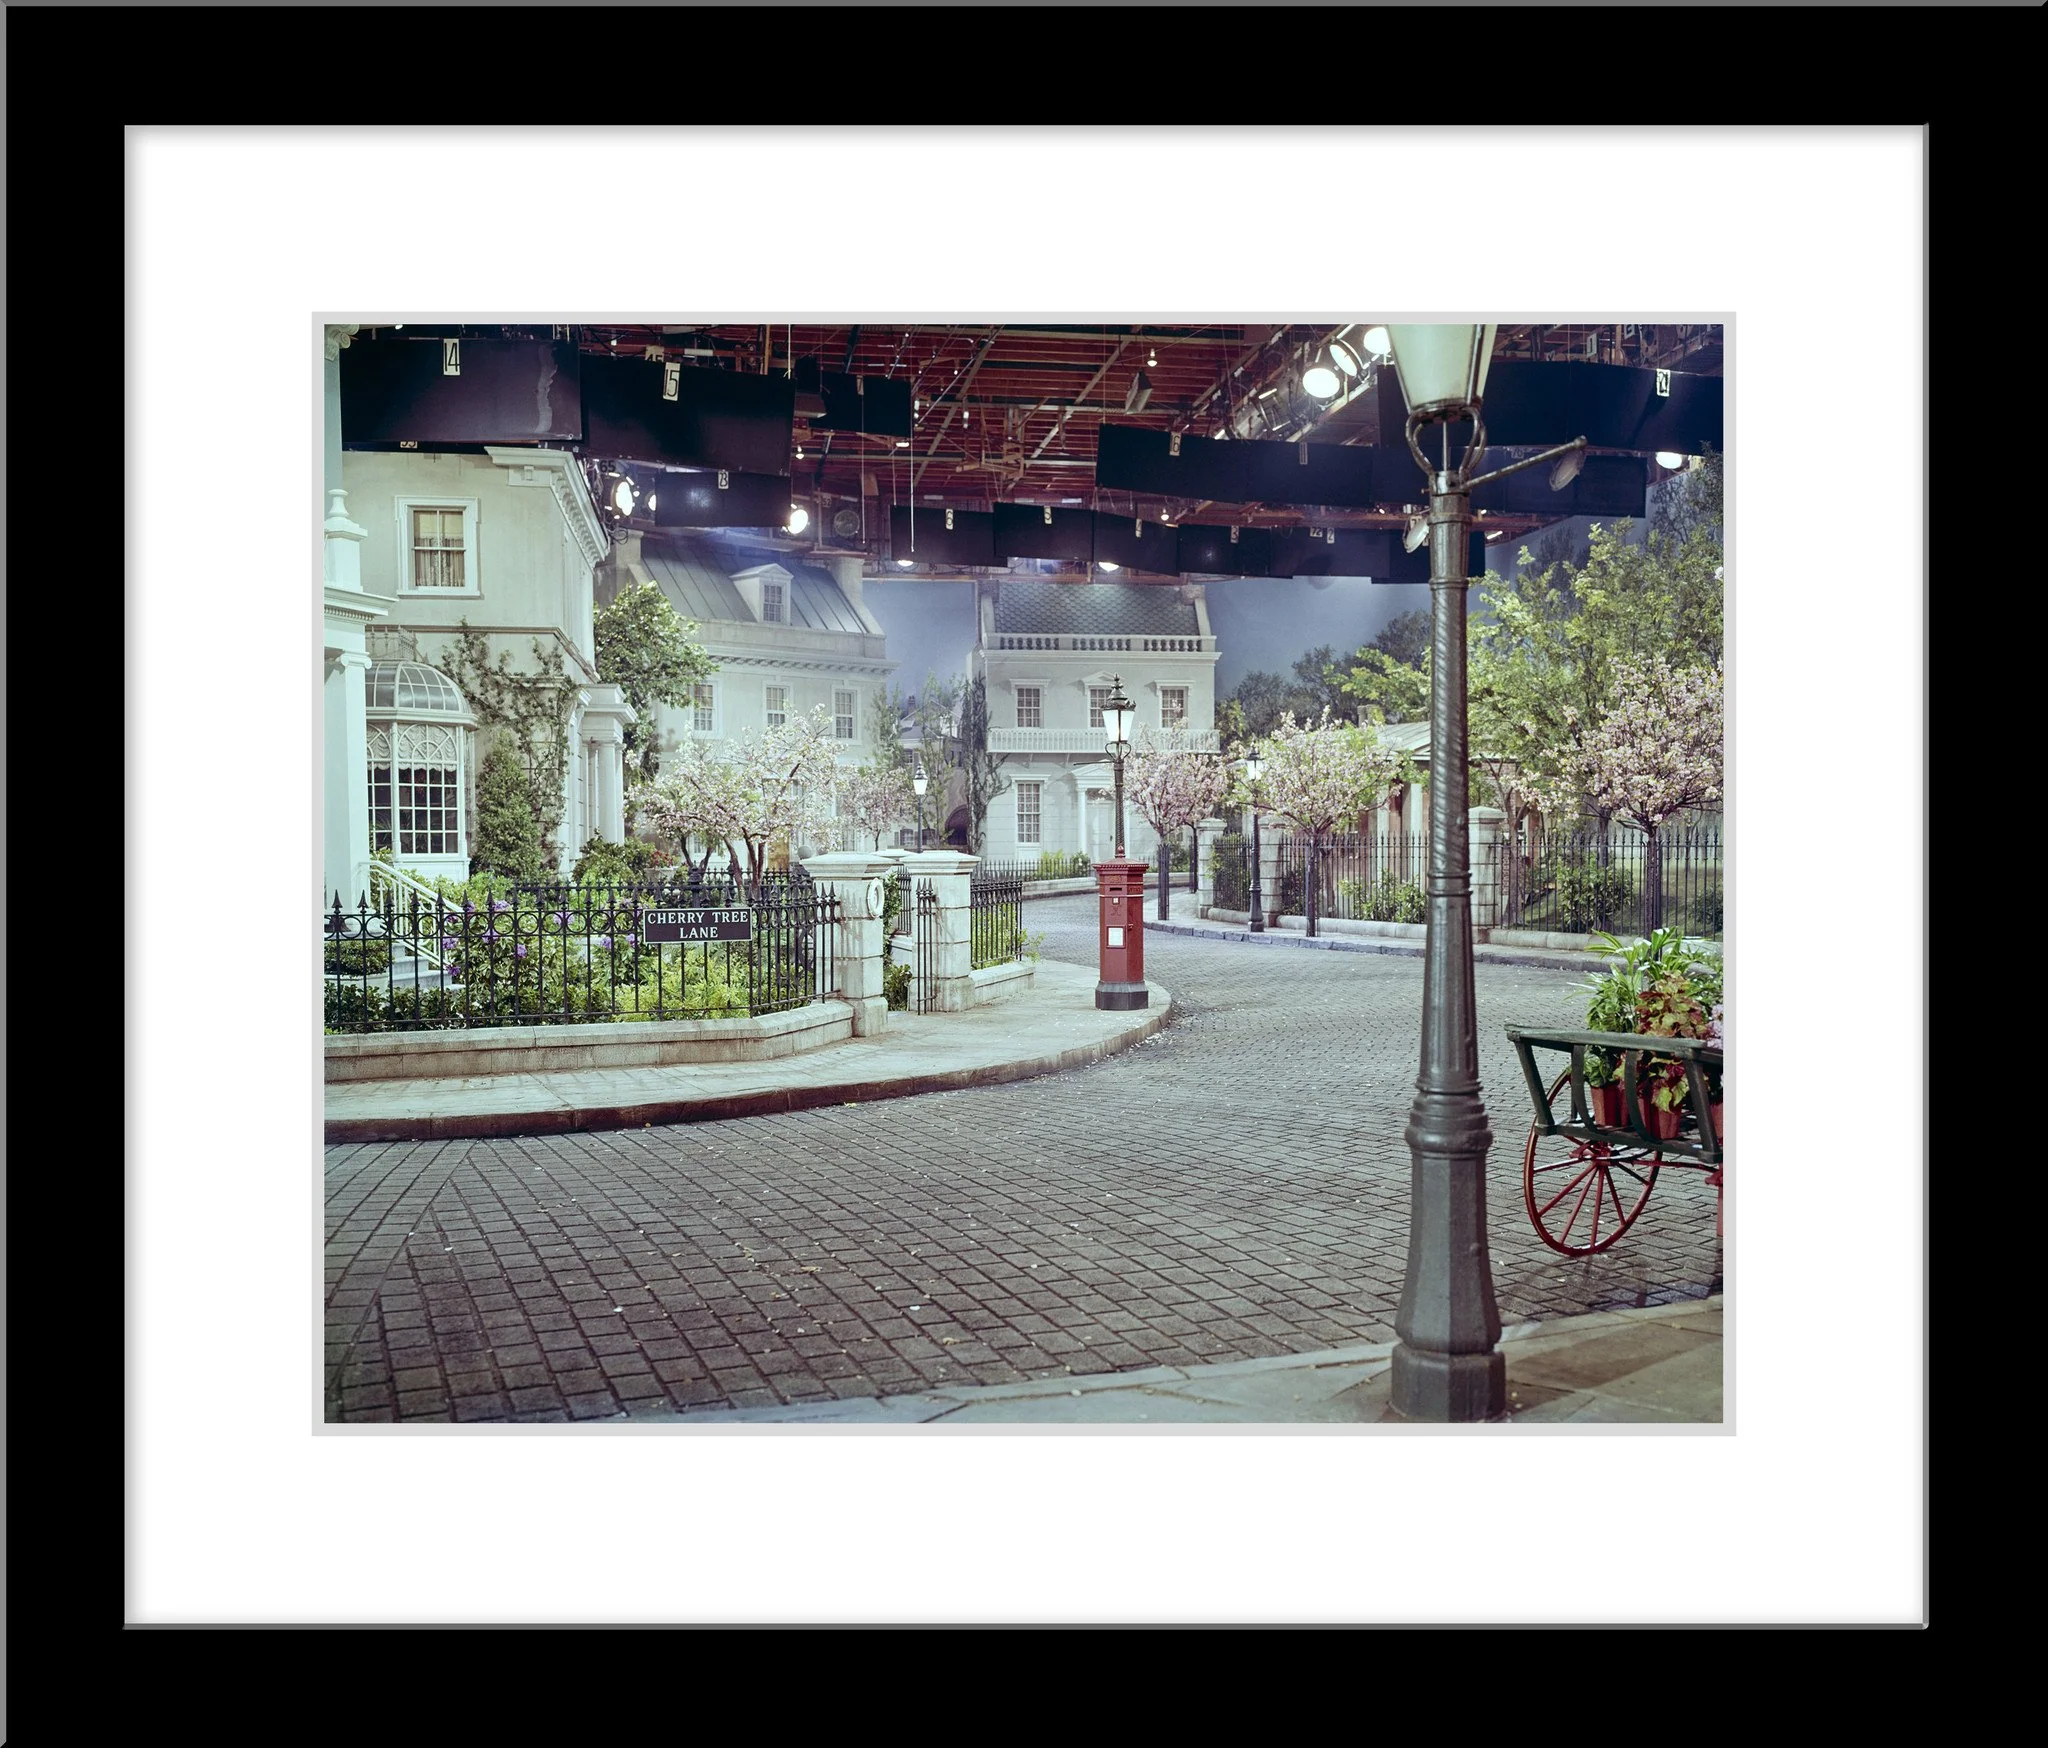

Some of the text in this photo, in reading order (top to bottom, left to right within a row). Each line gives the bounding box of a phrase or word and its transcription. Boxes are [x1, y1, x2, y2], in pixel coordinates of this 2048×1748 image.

[444, 342, 461, 372] 14
[664, 368, 681, 397] 15
[647, 911, 749, 925] CHERRY TREE
[679, 926, 719, 939] LANE
